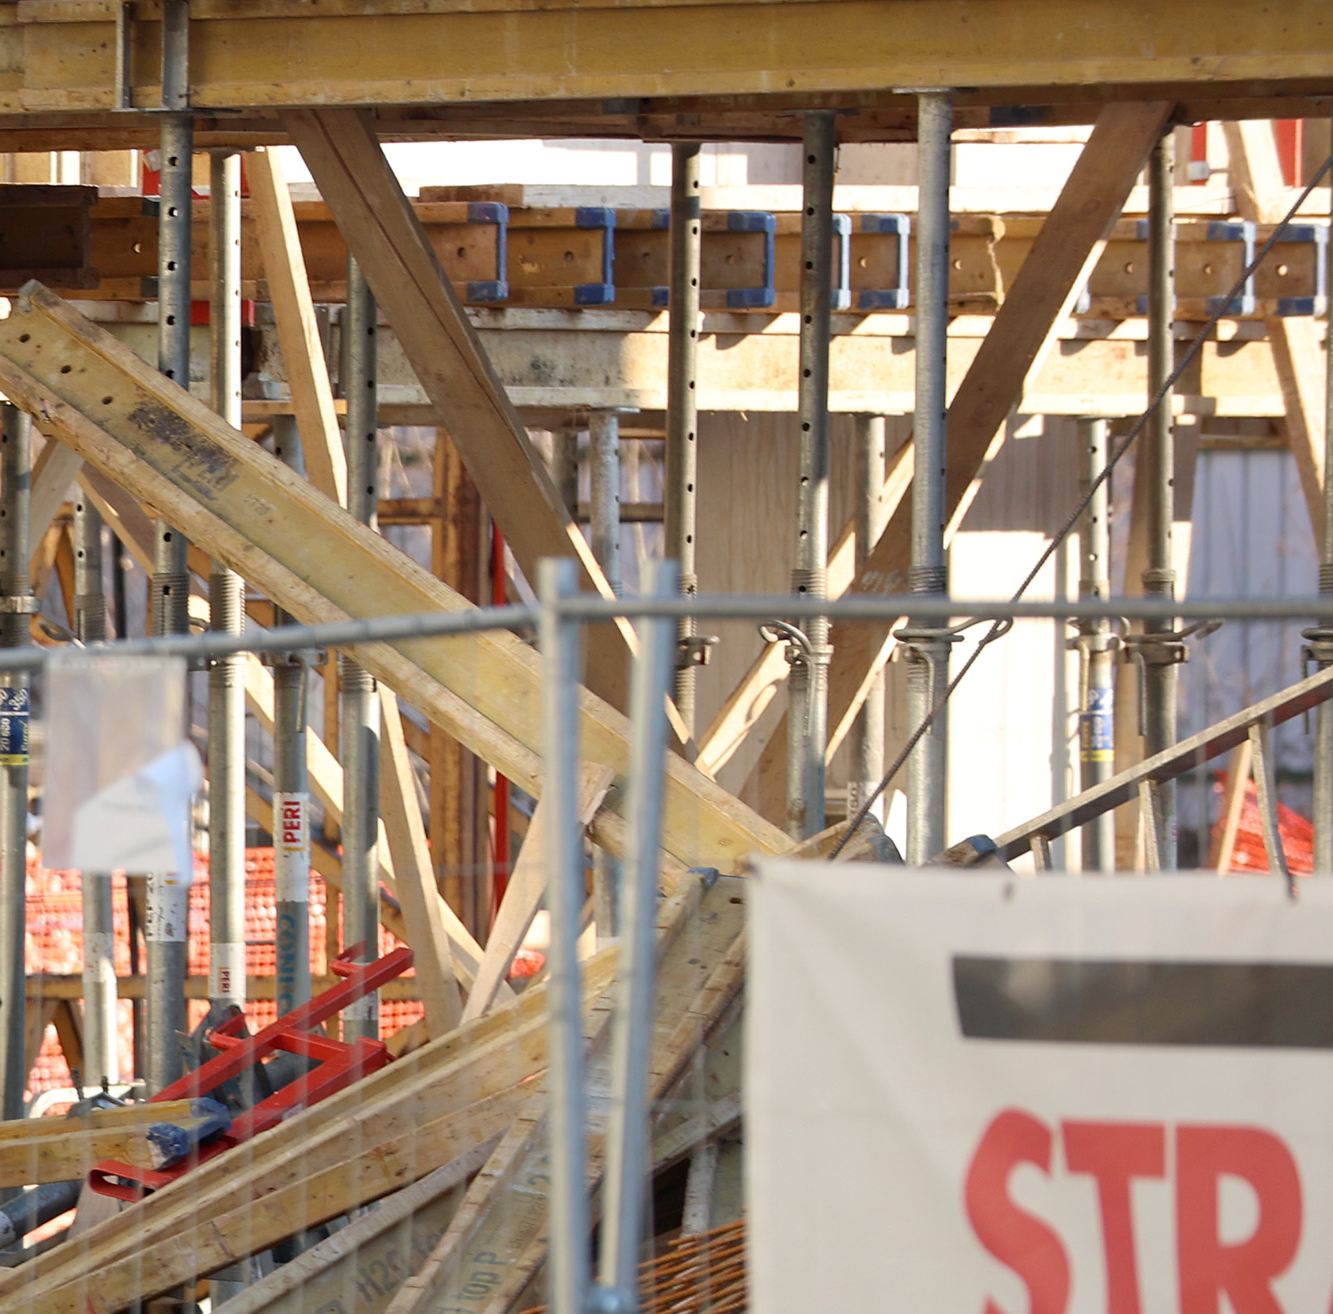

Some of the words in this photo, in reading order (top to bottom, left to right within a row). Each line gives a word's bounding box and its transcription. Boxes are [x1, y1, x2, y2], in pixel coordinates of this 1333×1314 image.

[282, 800, 302, 845] PERI
[220, 967, 231, 994] PERI
[472, 1249, 508, 1267] P
[452, 1267, 505, 1303] top
